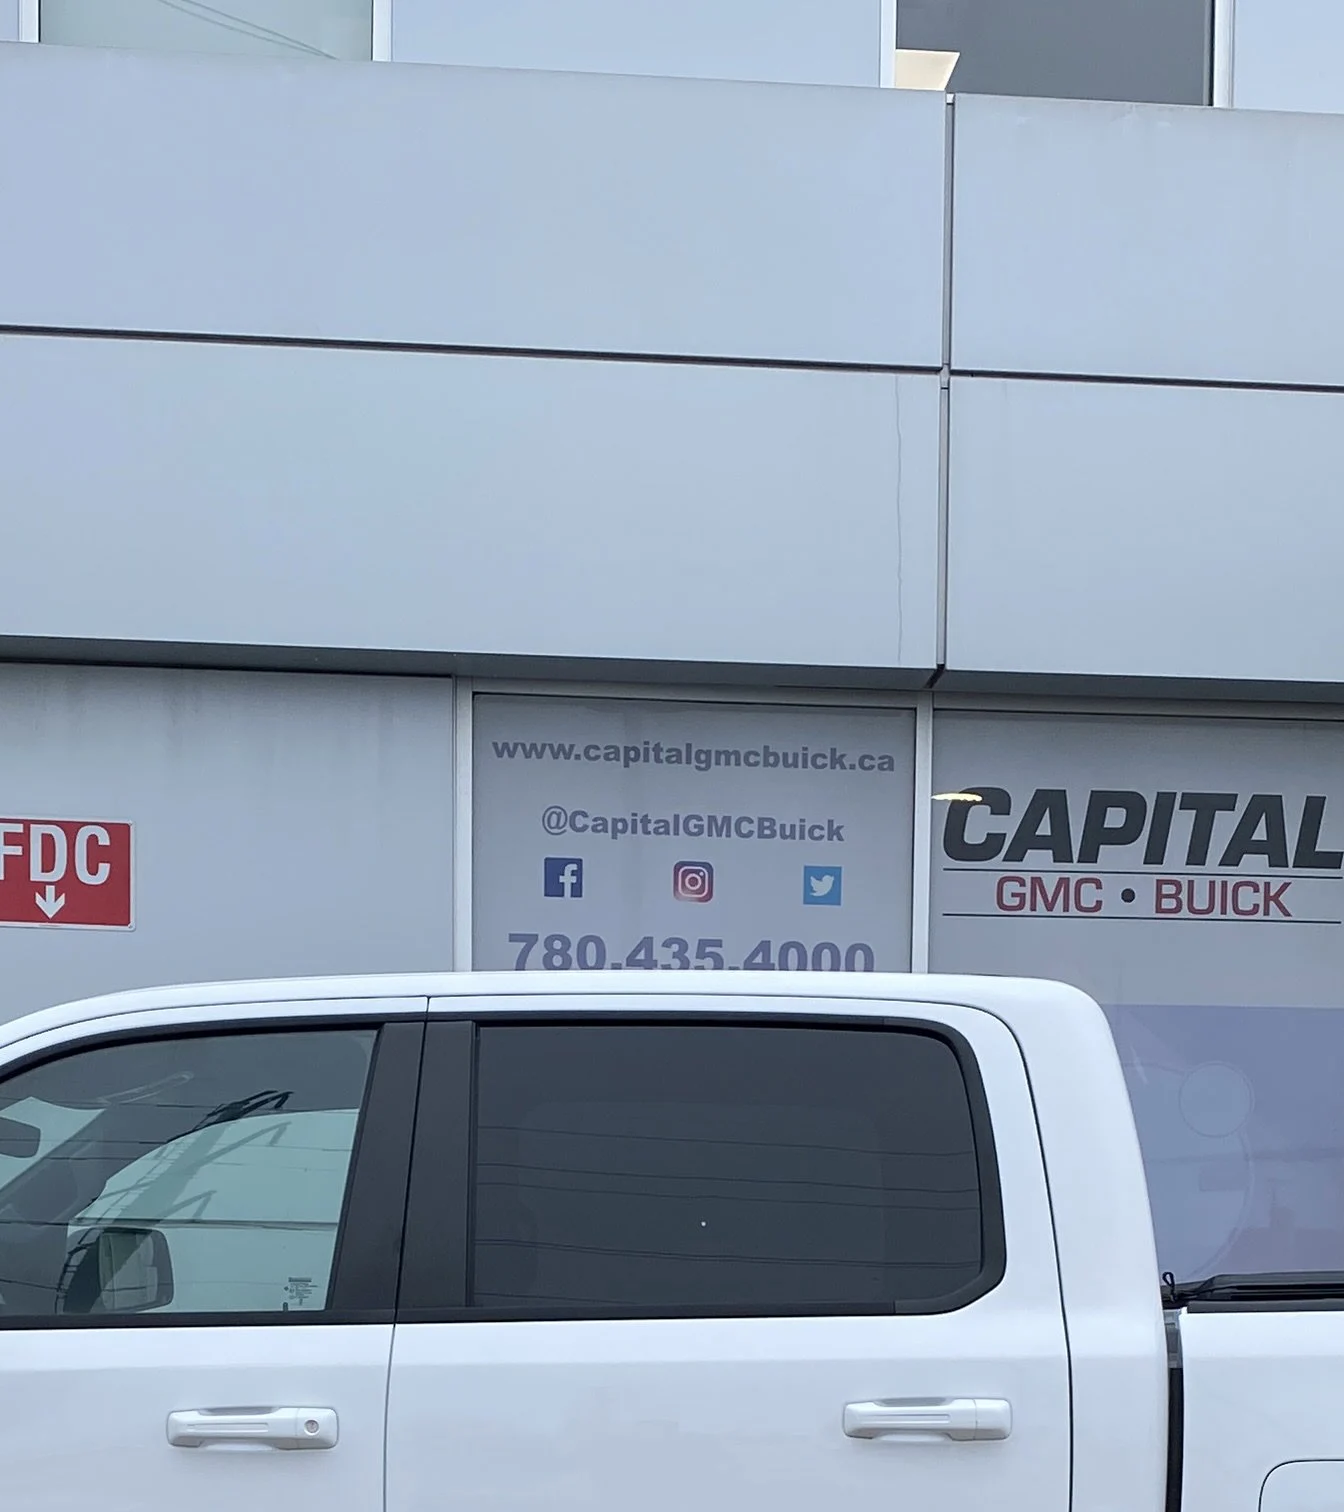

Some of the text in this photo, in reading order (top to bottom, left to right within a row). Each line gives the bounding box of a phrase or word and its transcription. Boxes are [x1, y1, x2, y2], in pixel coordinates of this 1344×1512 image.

[492, 740, 896, 773] www.capitalgmcbuick.ca
[541, 805, 845, 843] @CapitalGMCBuick
[942, 786, 1344, 870] CAPITAL
[996, 876, 1293, 917] GMC BUICK
